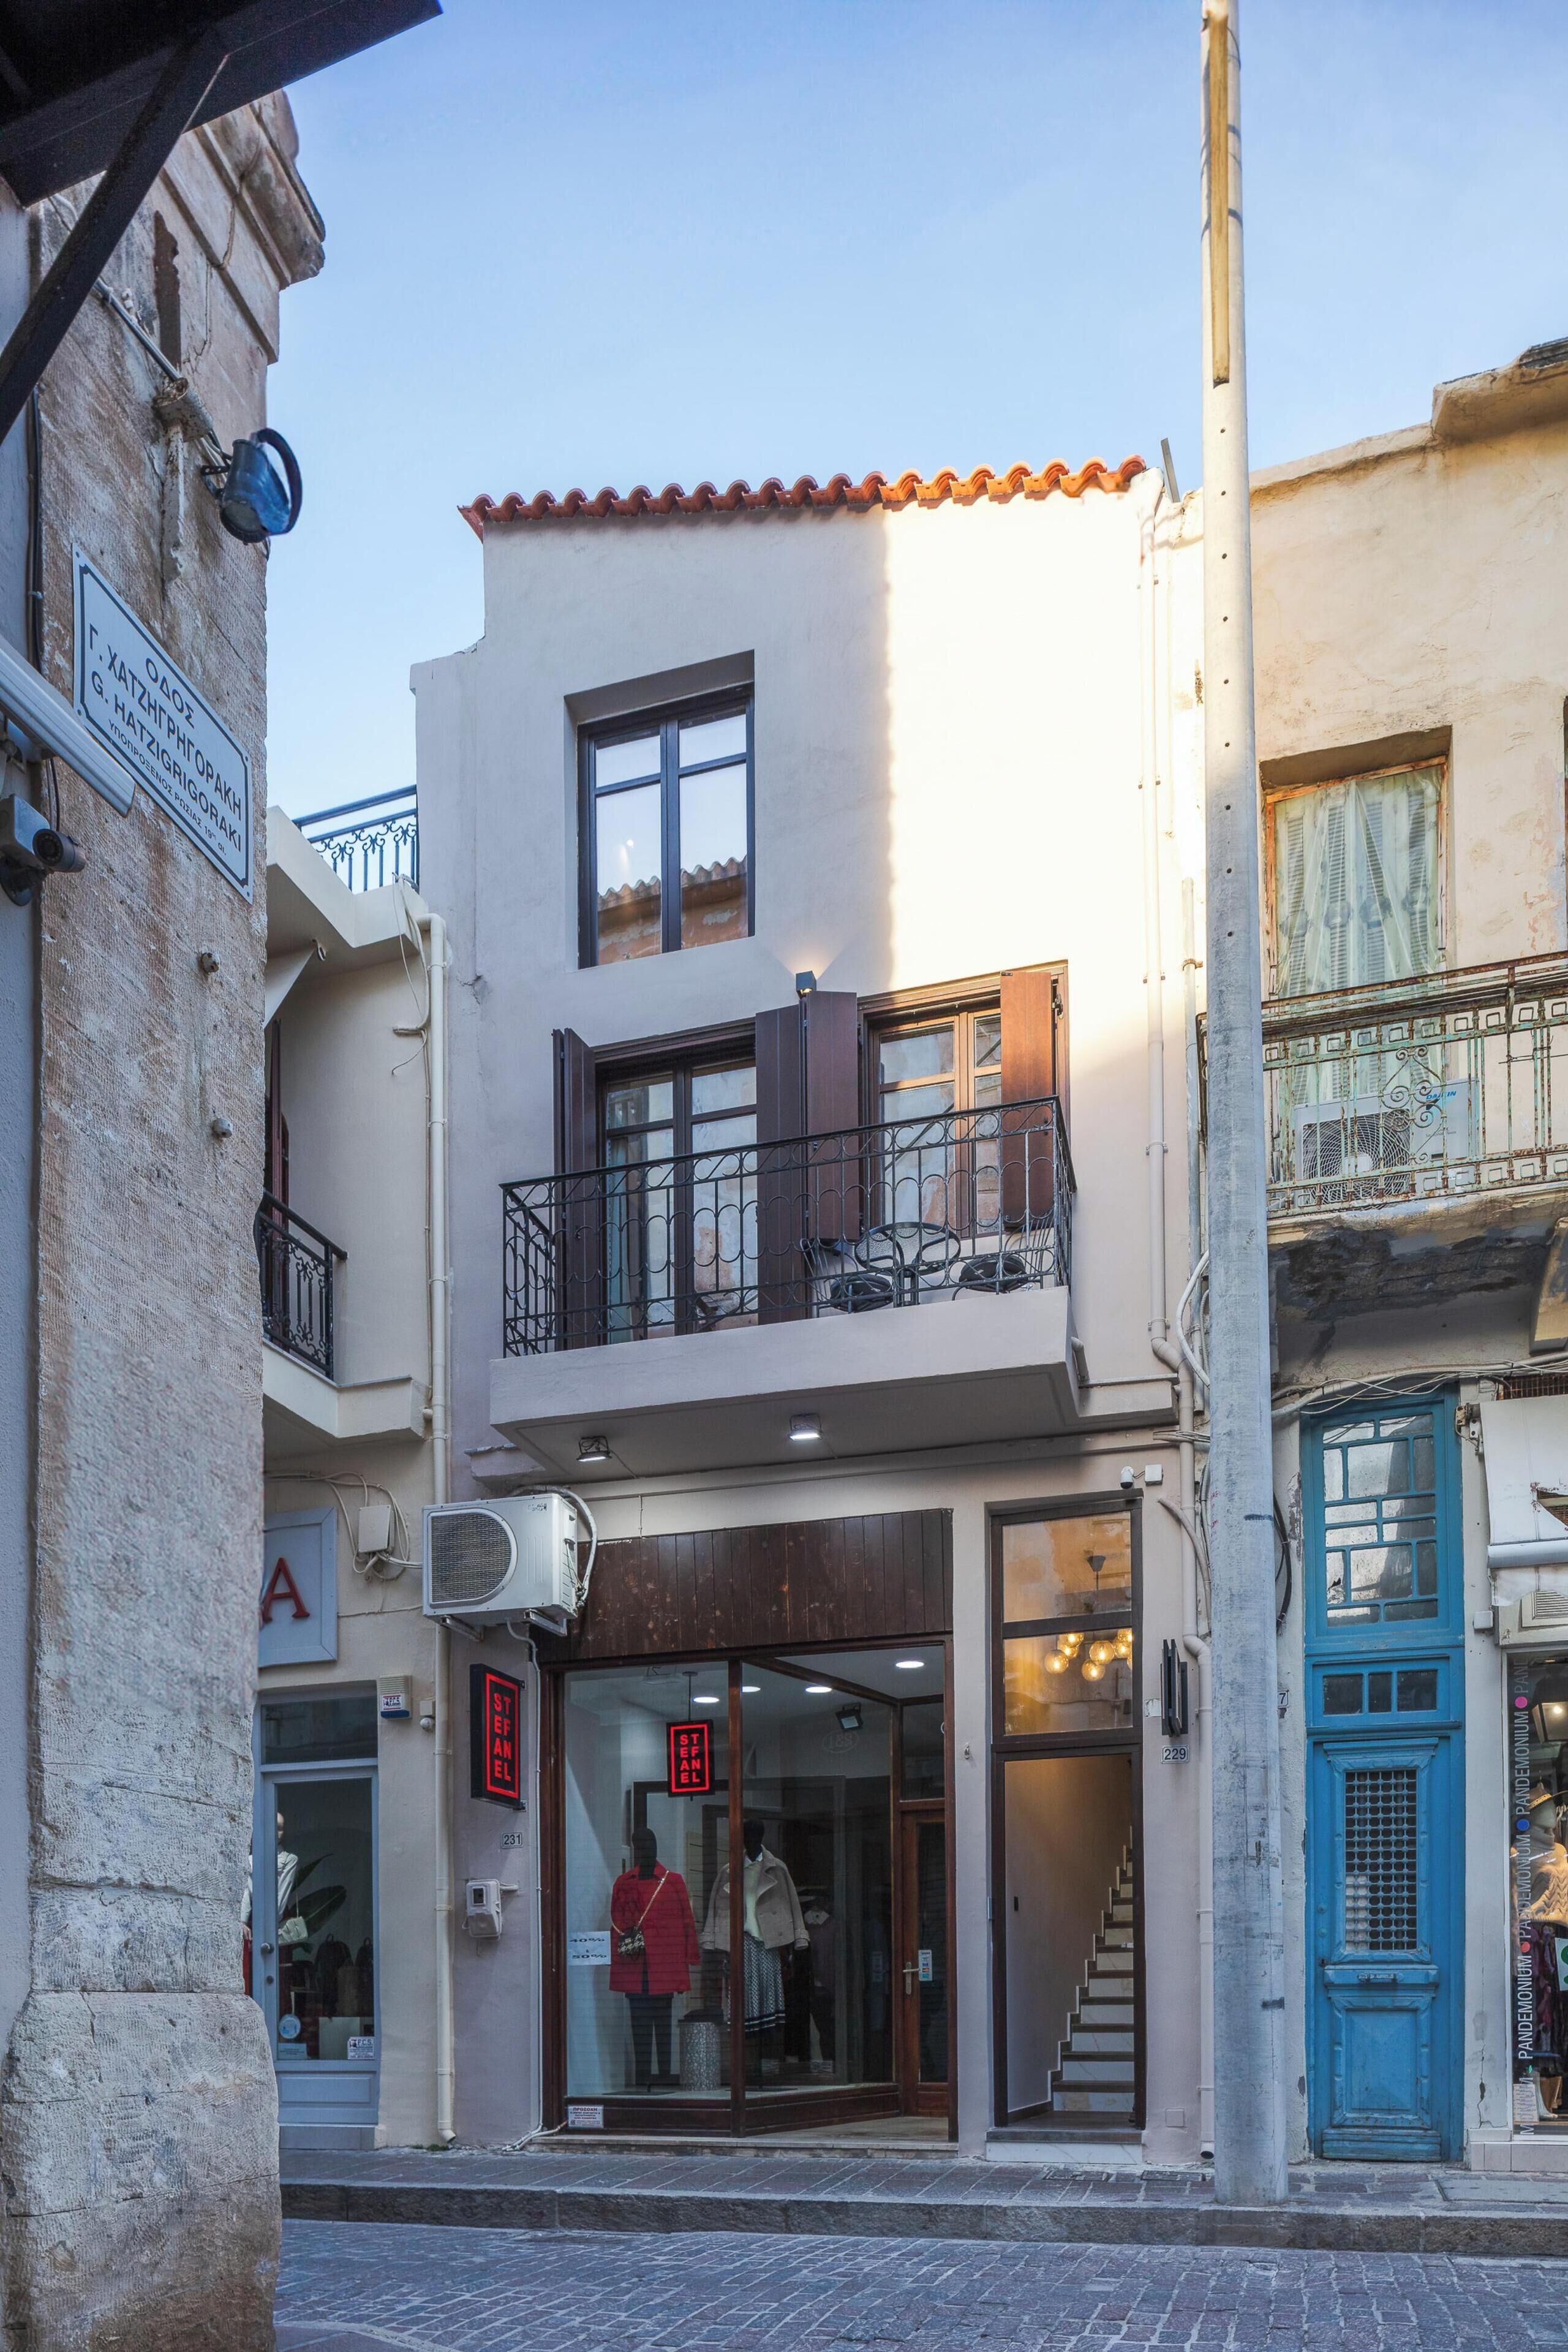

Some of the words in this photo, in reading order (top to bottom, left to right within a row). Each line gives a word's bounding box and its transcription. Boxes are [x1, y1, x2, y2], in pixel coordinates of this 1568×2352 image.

[89, 622, 103, 662] Γ.
[107, 644, 241, 821] ΧΑΤΖΗΓΡΗΓΟΡΑΚΗ
[146, 657, 194, 728] ΟΔΟΣ
[92, 671, 108, 704] G.
[114, 693, 241, 853] HATZIGRIGORAKI
[108, 718, 173, 796] ΥΠΟΠΡΟΞΕΝΟΣ
[174, 791, 202, 828] ΡΩΣΙΑΣ
[1164, 1747, 1186, 1760] 229
[1514, 1710, 1530, 1815] PANDEMONIUM
[503, 1834, 521, 1845] 231
[1517, 1955, 1533, 2059] PANDEMONIUM
